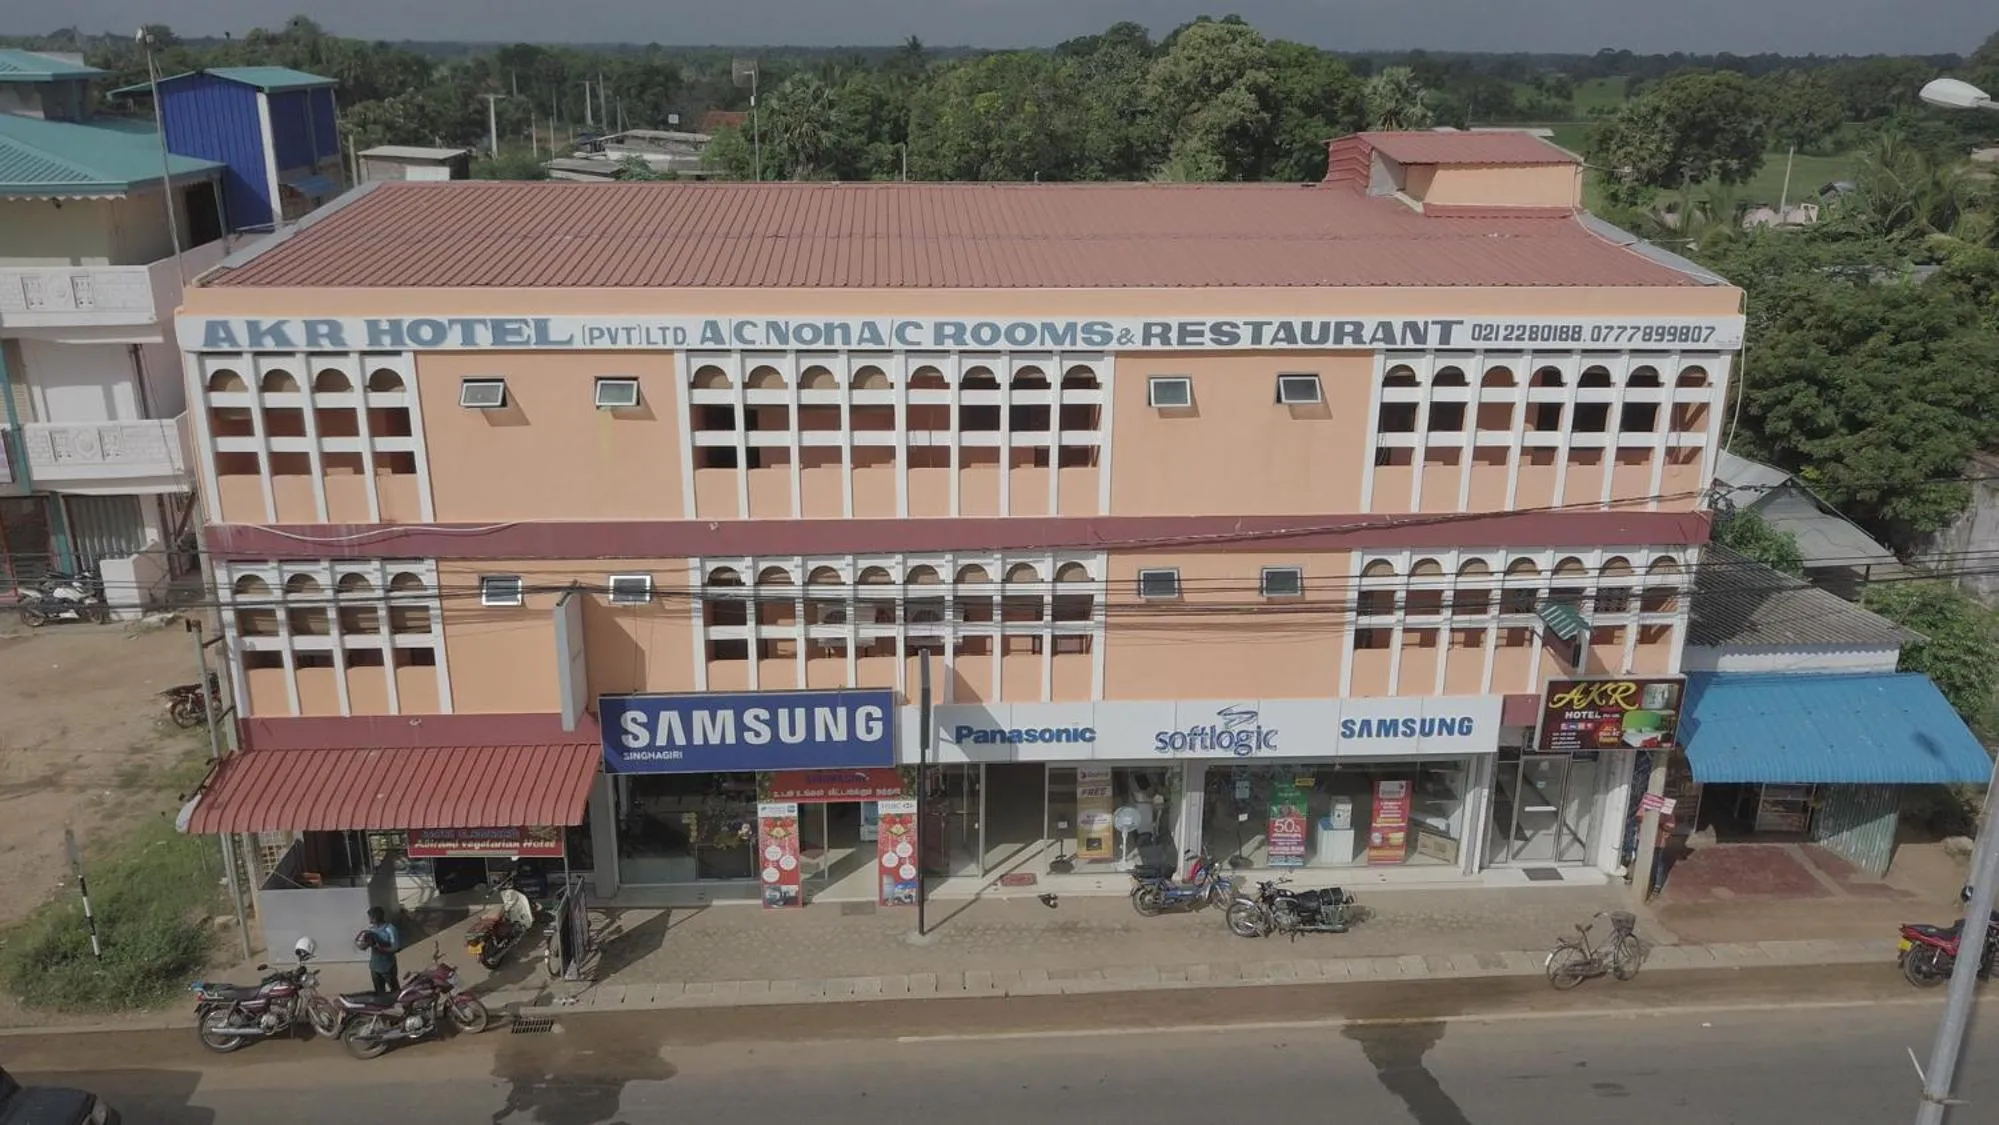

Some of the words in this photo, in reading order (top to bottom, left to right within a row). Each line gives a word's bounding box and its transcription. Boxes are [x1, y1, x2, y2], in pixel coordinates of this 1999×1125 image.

[203, 319, 349, 348] AKR
[363, 318, 574, 347] HOTEL
[933, 320, 1114, 346] ROOMS
[1116, 326, 1136, 345] &
[1142, 319, 1464, 346] RESTAURANT
[1549, 682, 1639, 710] AKR
[620, 705, 884, 749] SAMSUNG
[1565, 711, 1601, 719] HOTEL
[955, 725, 1097, 744] Panasonic
[1155, 724, 1279, 756] softlogic
[1341, 717, 1474, 739] SAMSUNG
[623, 751, 683, 761] SINGHAGIRI
